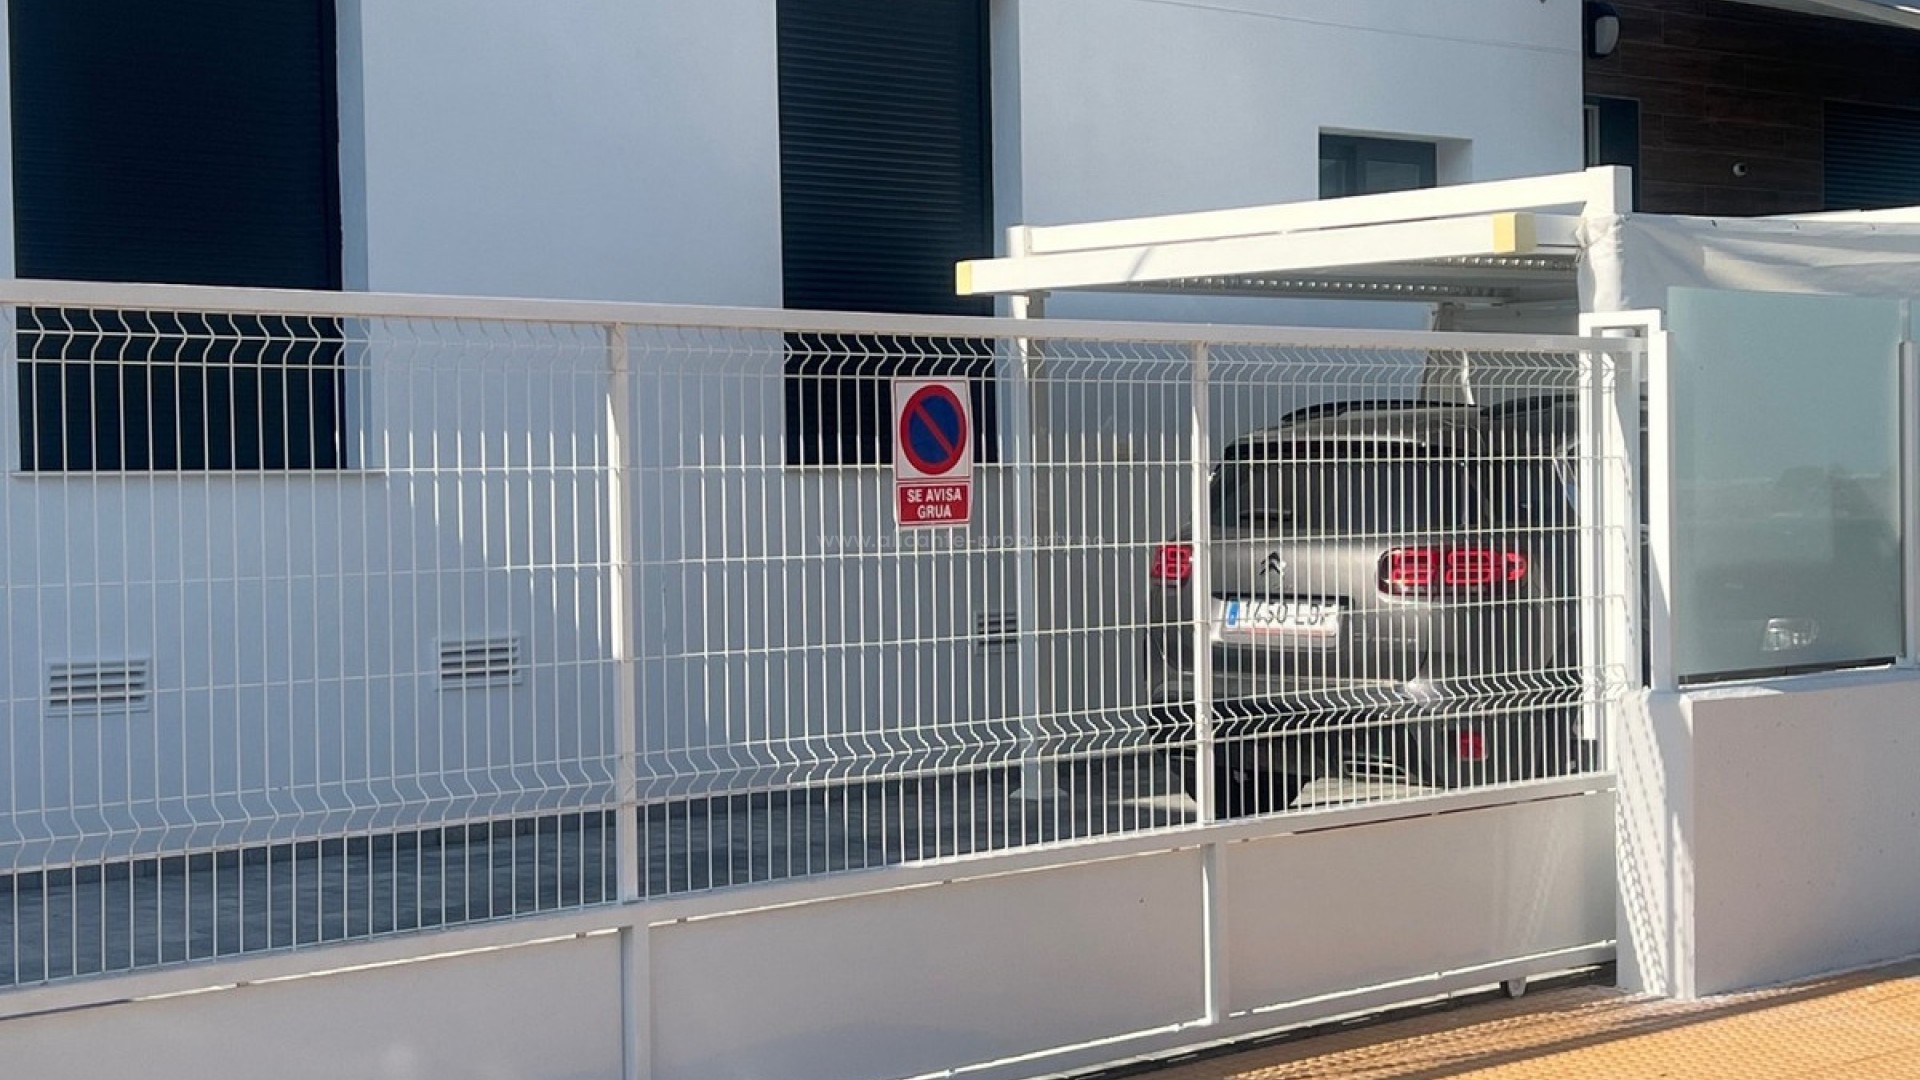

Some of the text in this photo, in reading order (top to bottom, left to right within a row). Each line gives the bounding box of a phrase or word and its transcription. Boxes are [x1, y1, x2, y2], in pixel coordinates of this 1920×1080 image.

[907, 488, 962, 503] SE AVISA
[917, 504, 952, 519] GRUA
